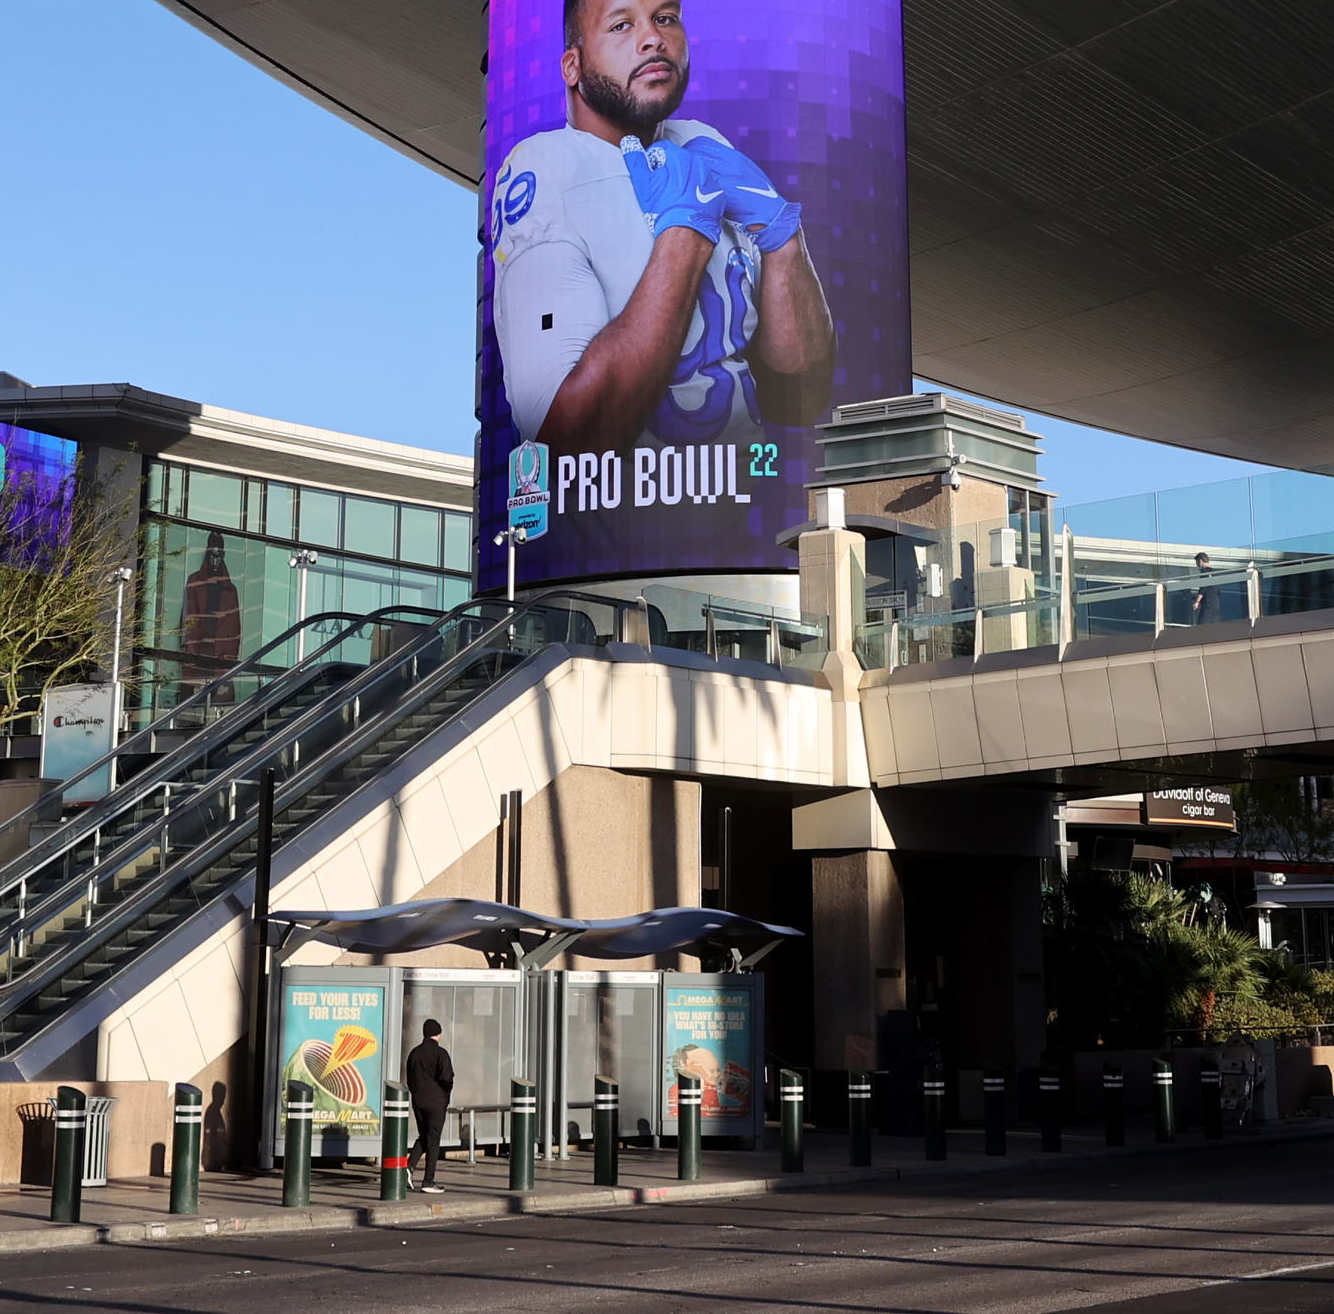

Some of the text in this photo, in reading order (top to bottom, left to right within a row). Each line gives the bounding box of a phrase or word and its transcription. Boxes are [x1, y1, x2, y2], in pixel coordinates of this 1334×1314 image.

[557, 443, 778, 515] PRO BOWL 22
[508, 493, 549, 509] PRO BOWL
[1205, 788, 1231, 805] Geneva
[1182, 803, 1215, 817] cigar bar
[292, 992, 379, 1007] FEED YOUR EYES
[309, 1006, 361, 1021] FOR LESS!
[674, 1011, 690, 1020] YOU
[692, 1011, 712, 1021] HAVE
[675, 1021, 706, 1030] WHAT'S
[691, 1030, 707, 1040] FOR
[311, 1109, 373, 1121] EGA MART
